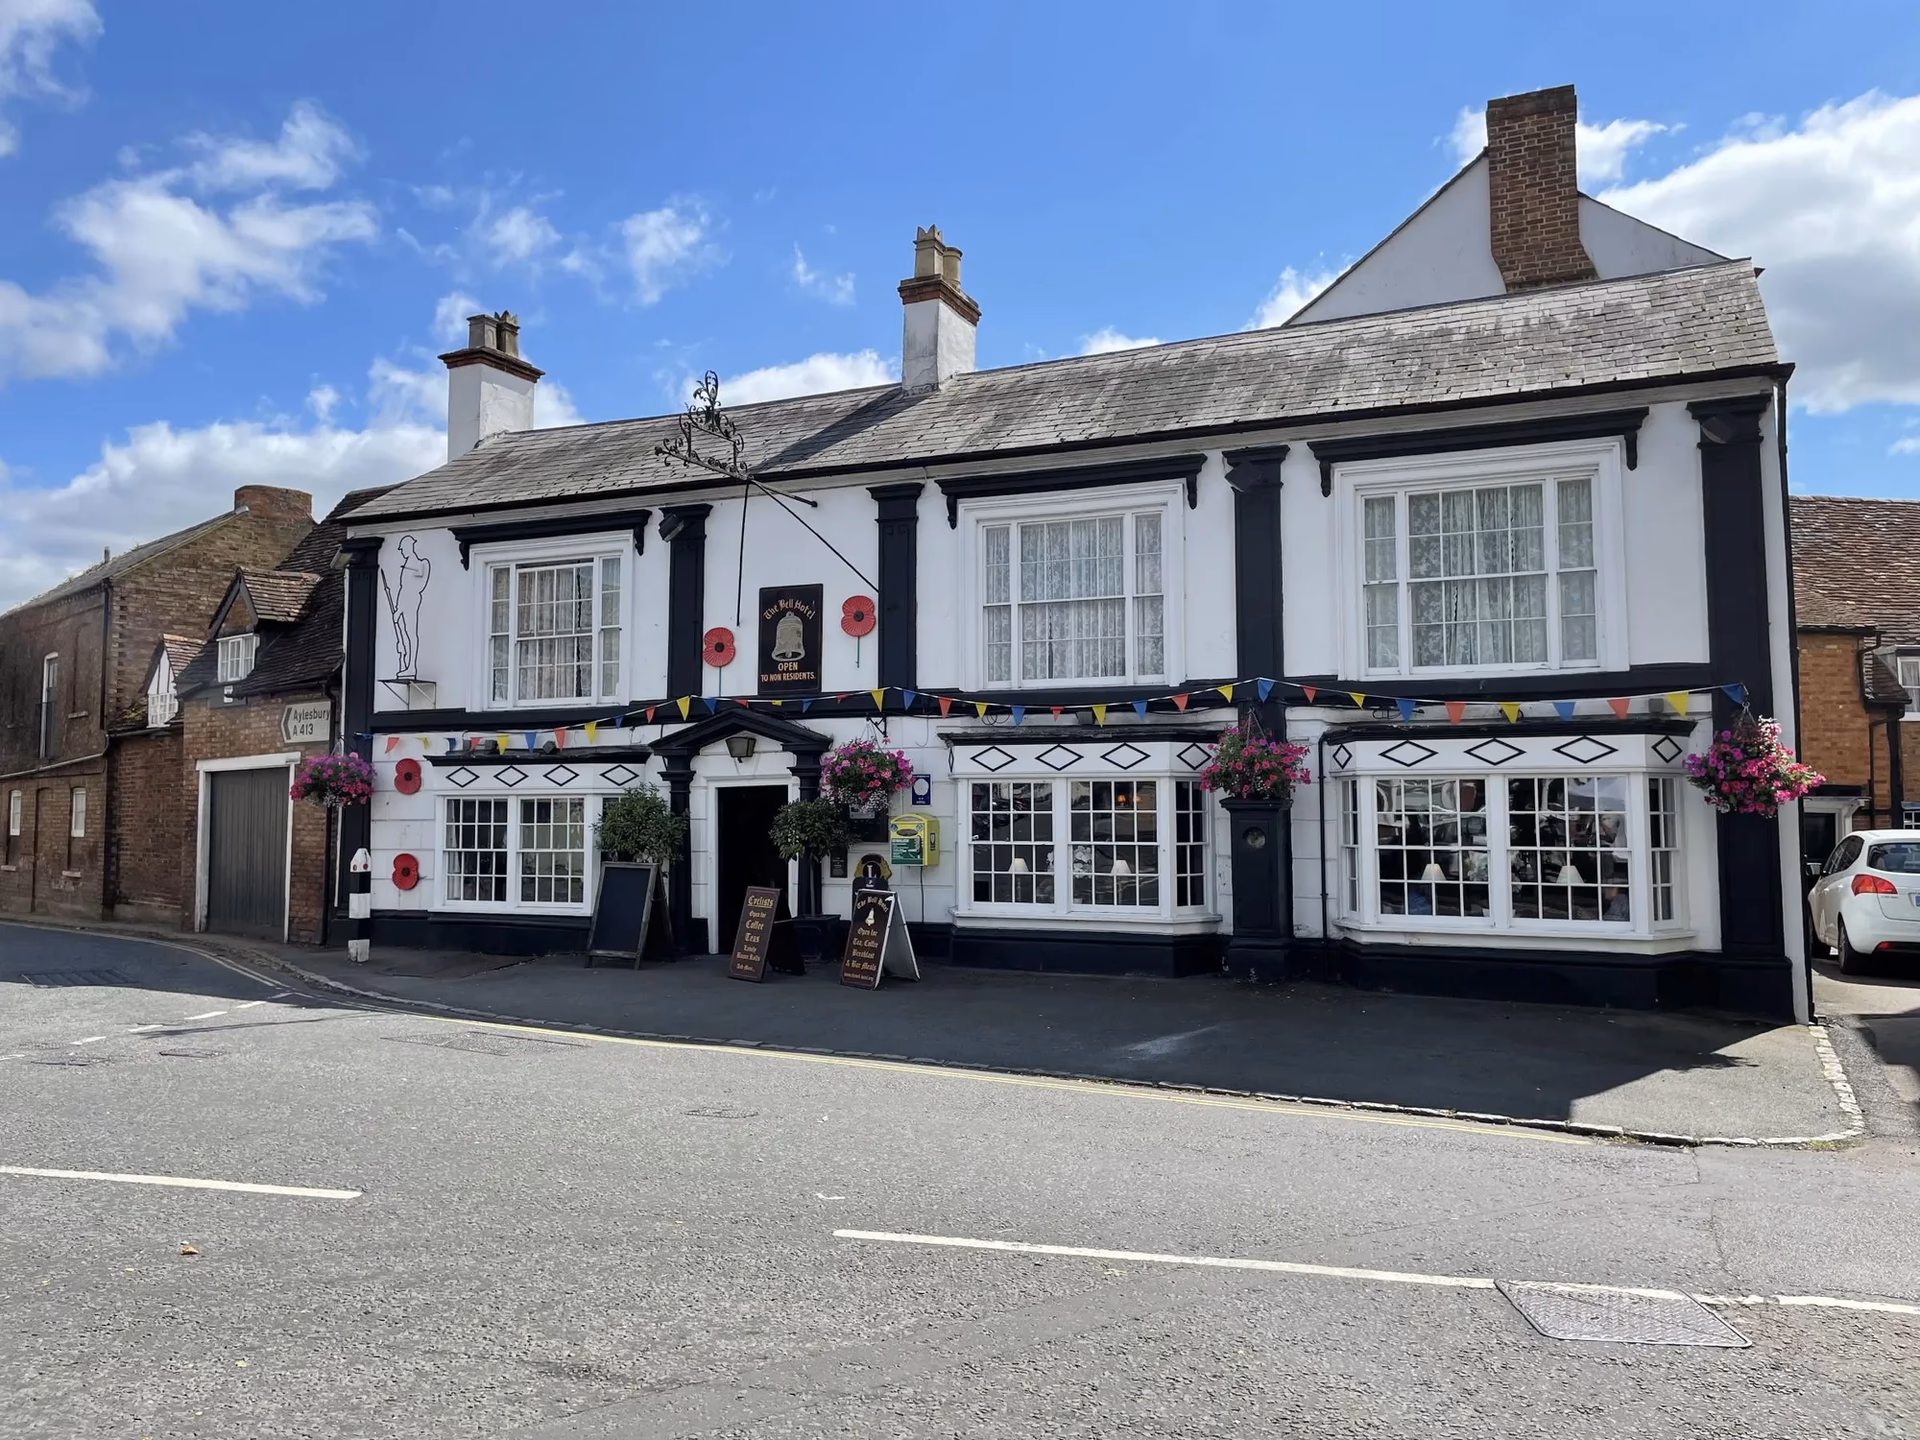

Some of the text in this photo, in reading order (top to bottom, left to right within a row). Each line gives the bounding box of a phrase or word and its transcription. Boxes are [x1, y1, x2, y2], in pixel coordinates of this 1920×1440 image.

[763, 598, 816, 620] The Bell Hotel
[778, 662, 798, 671] OPEN
[761, 674, 768, 682] TO
[769, 673, 782, 681] NON
[293, 708, 330, 723] Aylesbury
[293, 723, 314, 736] A 413
[748, 896, 774, 908] Cyclists
[857, 900, 866, 909] The
[745, 920, 764, 930] Coffee
[857, 927, 878, 937] Open for
[745, 933, 760, 943] Teas
[864, 939, 879, 948] Coffee
[852, 949, 875, 959] Breakfast
[861, 962, 877, 971] Meals
